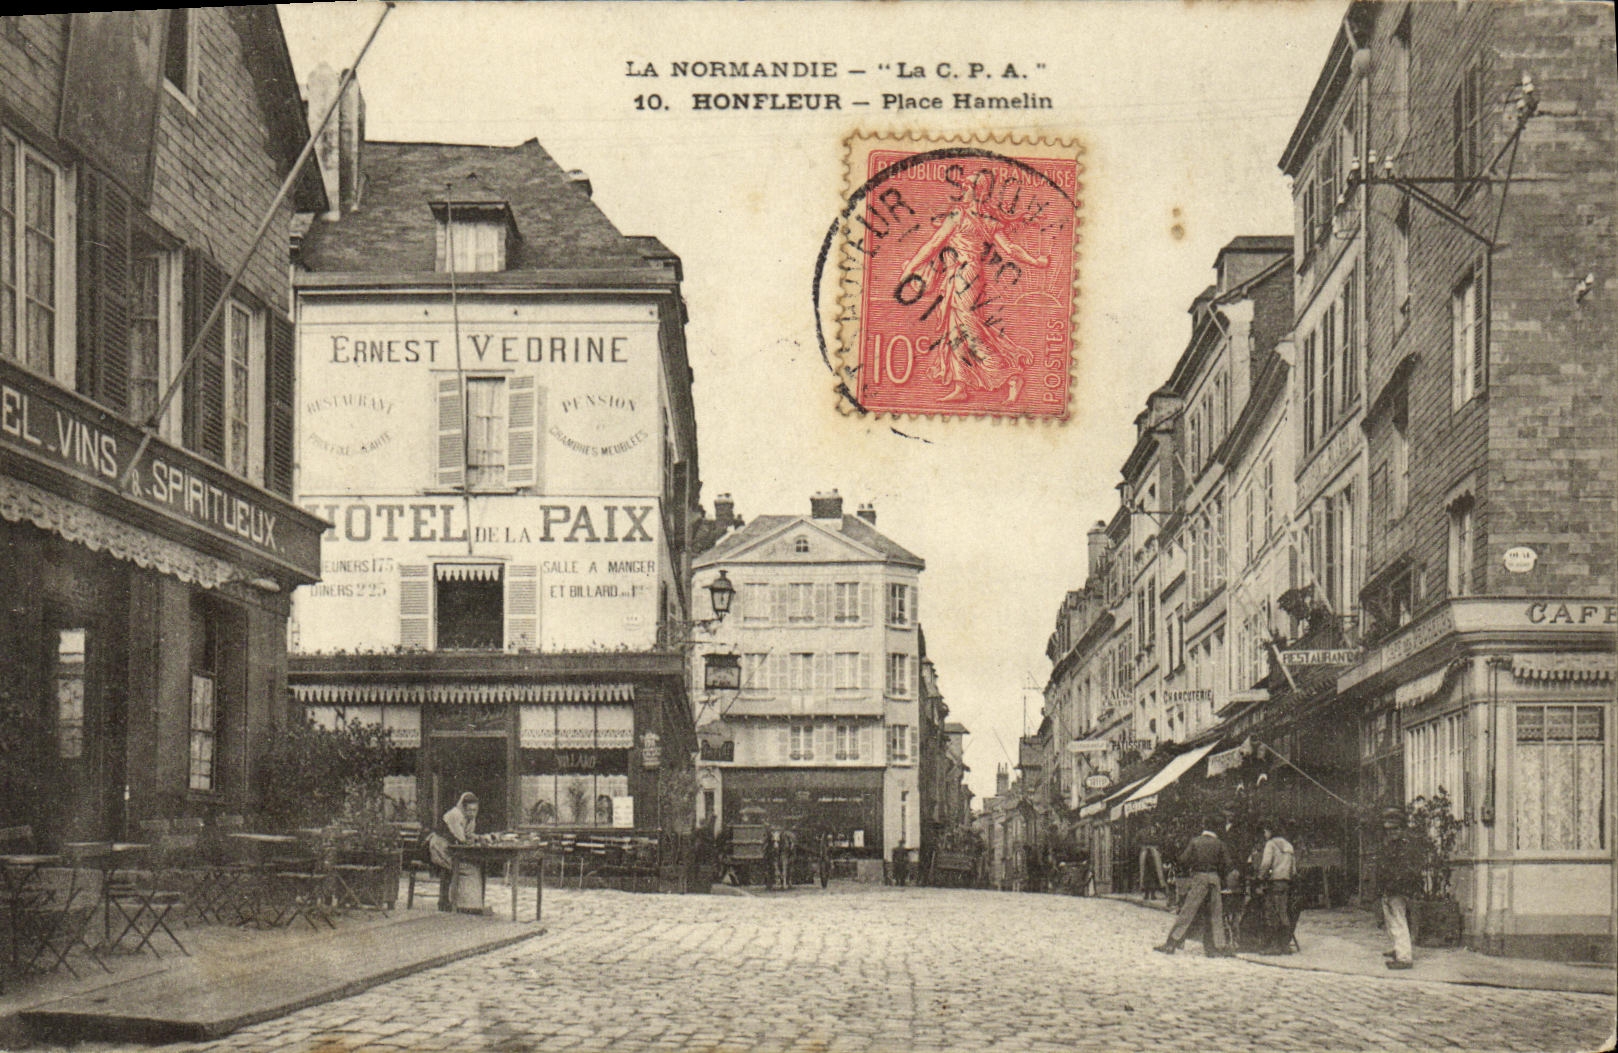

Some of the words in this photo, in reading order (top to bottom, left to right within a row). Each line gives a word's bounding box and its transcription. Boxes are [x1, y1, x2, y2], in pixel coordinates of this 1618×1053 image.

[329, 335, 439, 363] ERNEST
[467, 334, 629, 363] VEDRINE
[1042, 318, 1065, 403] POSTES
[561, 393, 636, 414] PENSION
[56, 410, 118, 479] VINS
[131, 468, 143, 497] &
[548, 424, 599, 457] CHAMBRES
[475, 526, 499, 543] DE
[505, 526, 531, 543] LA
[539, 504, 654, 542] PAIX
[543, 561, 578, 573] SALLE
[588, 561, 598, 573] A
[608, 560, 655, 573] MANGER
[550, 585, 564, 598] ET
[569, 585, 618, 598] BILLARD
